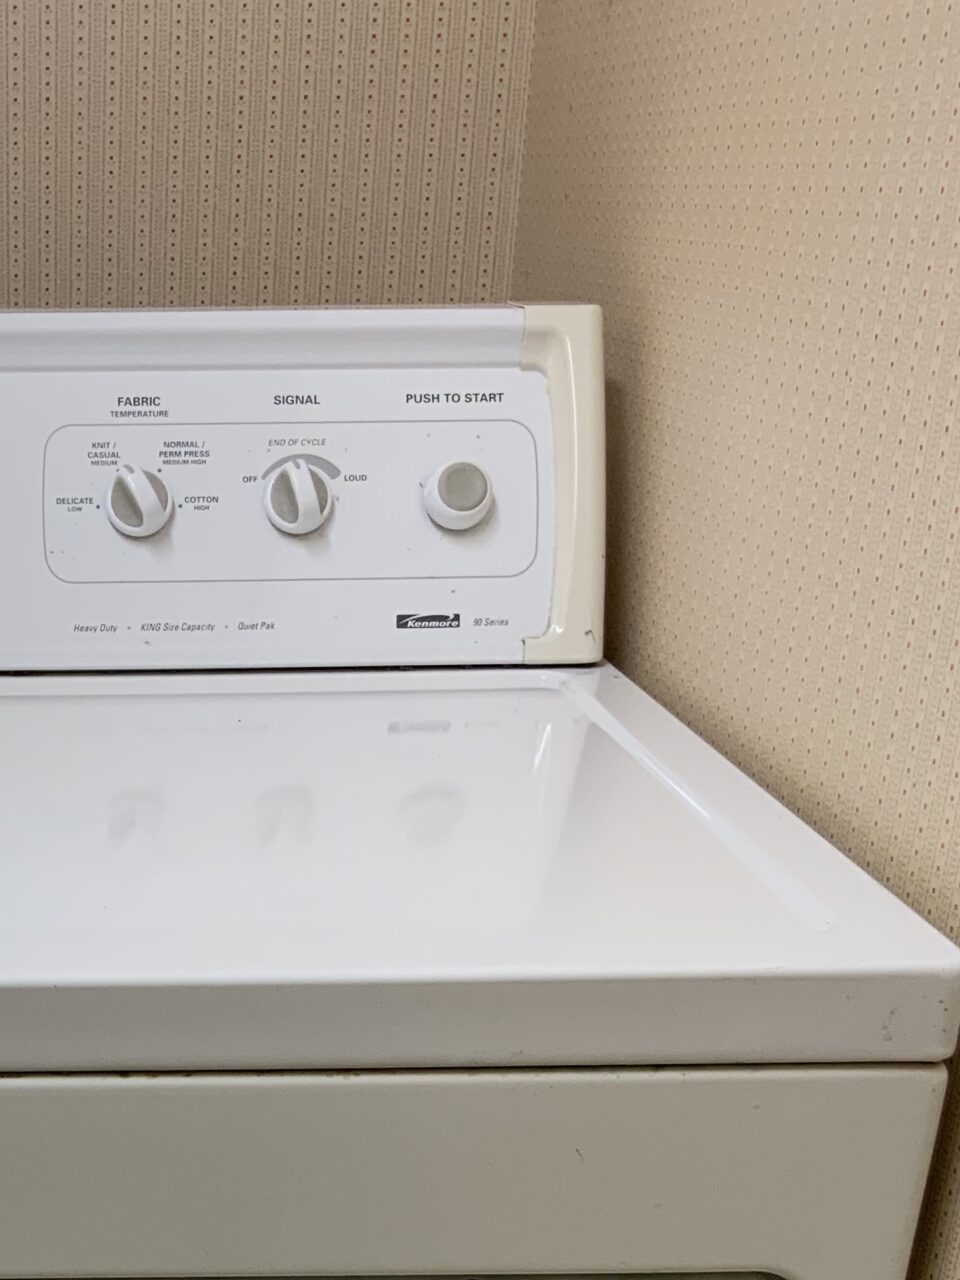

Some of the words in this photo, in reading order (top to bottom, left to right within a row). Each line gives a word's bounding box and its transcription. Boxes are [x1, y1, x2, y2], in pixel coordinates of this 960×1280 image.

[117, 396, 161, 407] FABRIC
[273, 395, 321, 405] SIGNAL
[406, 394, 440, 403] PUSH
[444, 393, 461, 403] TO
[464, 393, 504, 403] START
[110, 410, 169, 418] TEMPERATURE
[268, 439, 286, 447] END
[287, 438, 299, 447] OF
[300, 438, 327, 446] CYCLE
[87, 451, 120, 459] CASUAL
[159, 450, 182, 458] PERM
[242, 475, 258, 483] OFF
[344, 474, 367, 482] LOUD
[56, 497, 94, 505] DELICATE
[184, 496, 219, 504] COTTON
[237, 621, 259, 630] Quiet
[260, 621, 276, 630] Pak
[483, 617, 509, 626] Series
[73, 623, 98, 633] Heavy
[99, 623, 118, 632] Duty
[140, 623, 161, 631] KING
[162, 622, 180, 631] Size
[181, 622, 215, 633] Capacity
